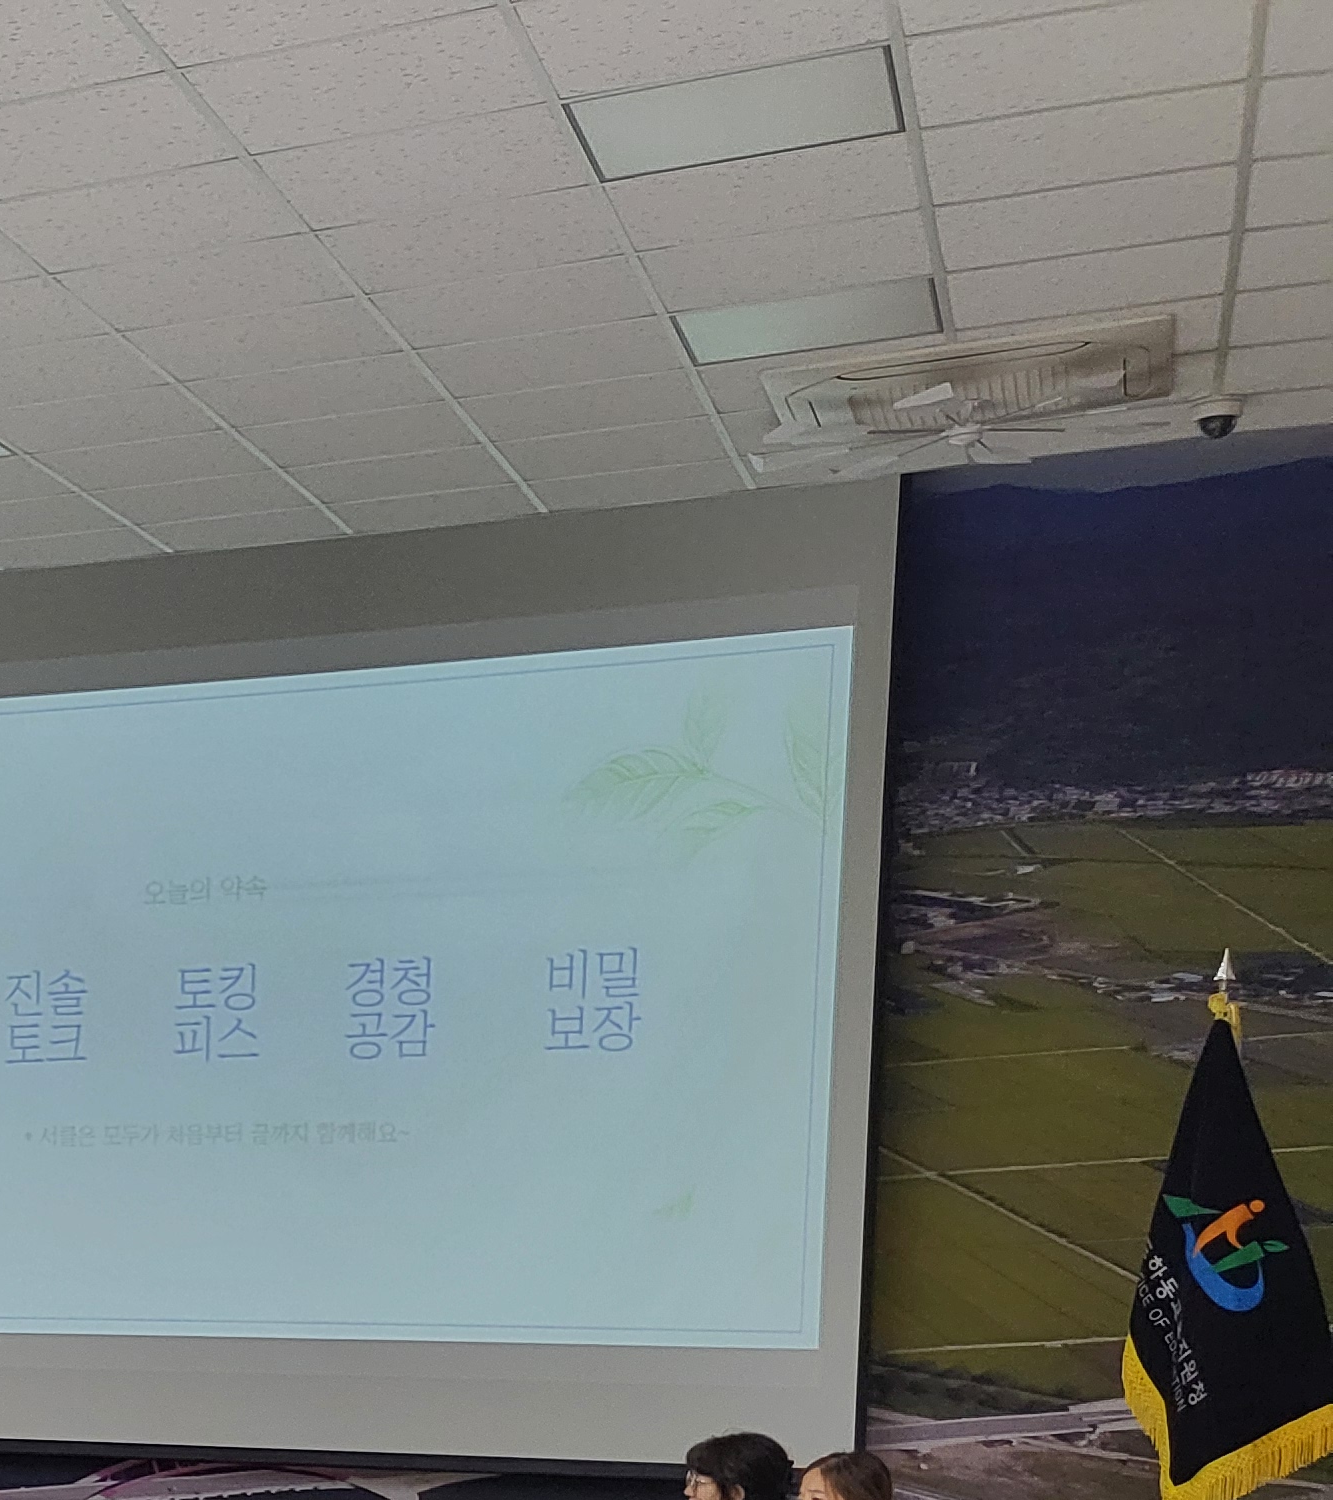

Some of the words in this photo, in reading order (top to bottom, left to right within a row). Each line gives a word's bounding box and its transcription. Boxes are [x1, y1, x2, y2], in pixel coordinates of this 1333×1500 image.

[144, 876, 210, 905] 오늘의
[220, 875, 267, 901] 약속
[4, 968, 89, 1017] 진솔
[174, 962, 257, 1011] 토킹
[345, 955, 432, 1008] 경청
[546, 946, 640, 1000] 비밀
[4, 1023, 88, 1065] 토크
[173, 1015, 260, 1063] 피스
[344, 1008, 436, 1060] 공감
[544, 1001, 642, 1052] 보장
[38, 1125, 96, 1147] 서클은
[102, 1124, 161, 1146] 모두가
[166, 1122, 244, 1145] 처음부터
[1148, 1308, 1171, 1327] OF
